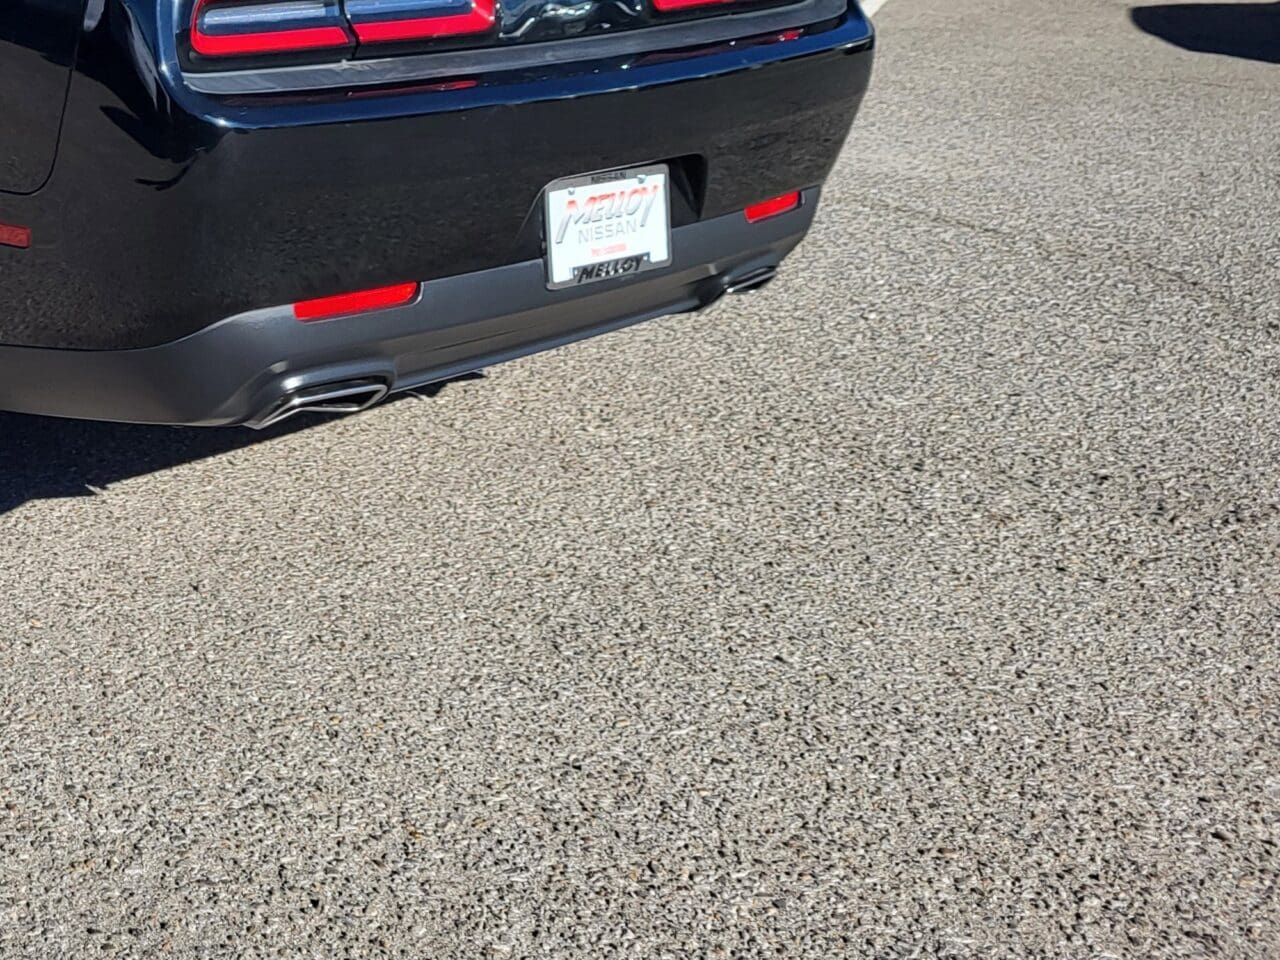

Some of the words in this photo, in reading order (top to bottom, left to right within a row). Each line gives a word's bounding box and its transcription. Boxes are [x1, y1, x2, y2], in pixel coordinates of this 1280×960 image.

[555, 185, 660, 245] MELLOY
[578, 219, 638, 244] NISSAN
[577, 257, 645, 283] MELLOY
